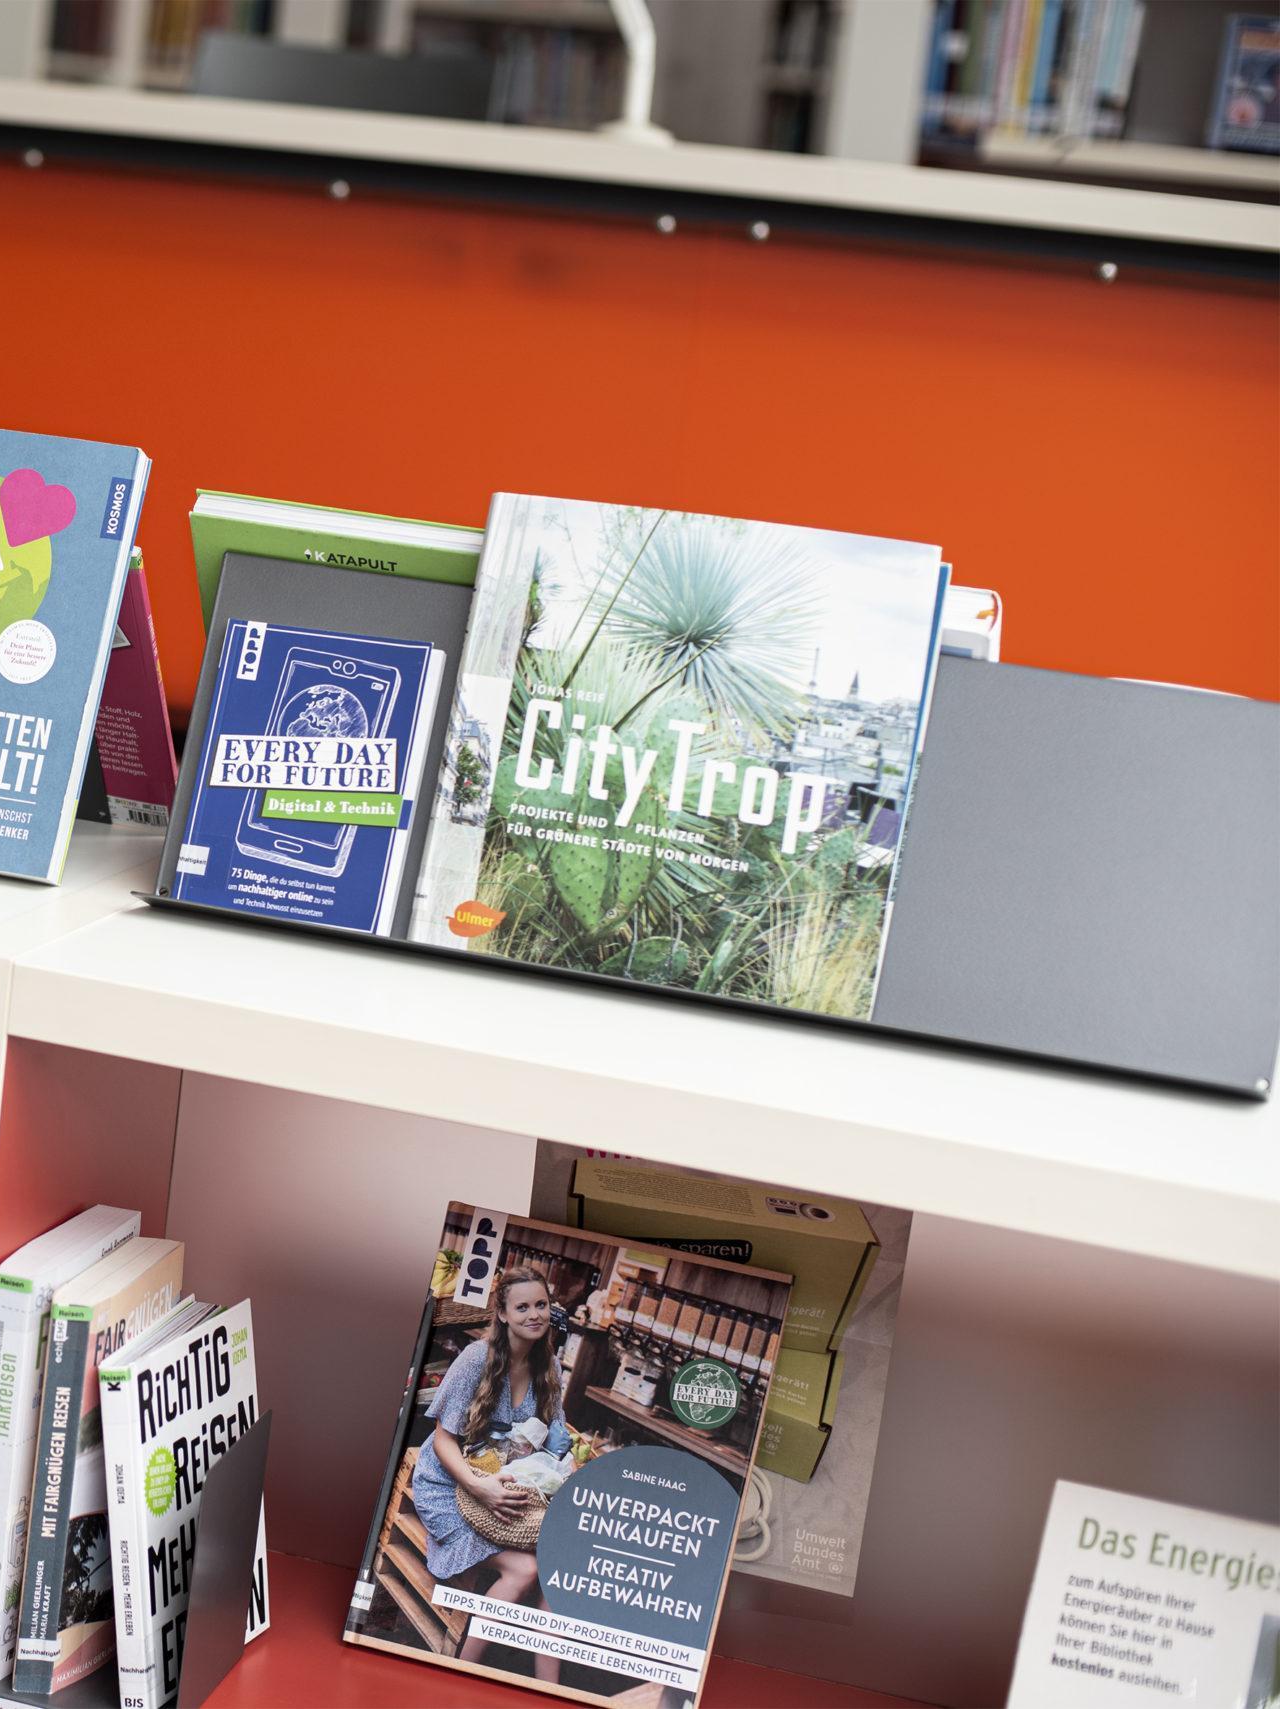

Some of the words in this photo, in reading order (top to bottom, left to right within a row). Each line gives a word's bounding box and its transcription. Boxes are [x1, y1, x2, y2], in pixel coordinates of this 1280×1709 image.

[107, 484, 125, 534] KOSMOS
[315, 550, 397, 572] KATAPULT
[242, 627, 266, 675] TOPP
[532, 683, 572, 699] JONAS
[223, 739, 321, 764] EVERY
[335, 742, 396, 766] DAY
[220, 764, 271, 784] FOR
[286, 766, 391, 788] FUTURE
[515, 698, 828, 854] CityTrop
[268, 799, 320, 813] Digital
[324, 802, 336, 813] &
[340, 801, 395, 815] Technik
[509, 804, 573, 823] PROJEKTE
[578, 815, 608, 829] UND
[636, 824, 705, 844] PFLANZEN
[507, 823, 532, 836] FÜR
[536, 828, 598, 847] GRÜNERE
[602, 838, 651, 857] STÄDTE
[655, 847, 684, 862] VON
[689, 854, 749, 872] MORGEN
[232, 868, 242, 877] 75
[244, 870, 268, 883] Dinge,
[288, 880, 304, 888] selbst
[238, 884, 287, 899] nachhaltiger
[288, 891, 313, 902] online
[457, 910, 495, 927] Ulmer
[462, 1218, 497, 1297] TOPP
[677, 1393, 694, 1401] FOR
[698, 1396, 733, 1406] FUTURE
[678, 1386, 710, 1395] EVERY
[715, 1390, 734, 1399] DAY
[53, 1387, 71, 1429] REISEN
[44, 1432, 66, 1513] FAIRGNÜGEN
[622, 1469, 656, 1484] SABINE
[658, 1478, 687, 1492] HAAG
[572, 1487, 719, 1536] UNVERPACKT
[41, 1516, 56, 1538] MIT
[578, 1512, 701, 1558] EINKAUFEN
[796, 1528, 846, 1549] Umwelt
[1077, 1517, 1137, 1560] Das
[792, 1554, 820, 1570] Amt
[794, 1541, 844, 1561] Bundes
[588, 1556, 673, 1591] KREATIV
[547, 1570, 702, 1622] AUFBEWAHREN
[443, 1592, 476, 1609] TIPPS,
[479, 1601, 520, 1620] TRICKS
[523, 1612, 547, 1626] UND
[550, 1619, 632, 1648] DIY-PROJEKTE
[635, 1640, 668, 1656] RUND
[671, 1648, 690, 1662] UM
[480, 1625, 597, 1662] VERPACKUNGSFREIE
[600, 1655, 682, 1684] LEBENSMITTEL
[1051, 1653, 1114, 1678] kostenlos
